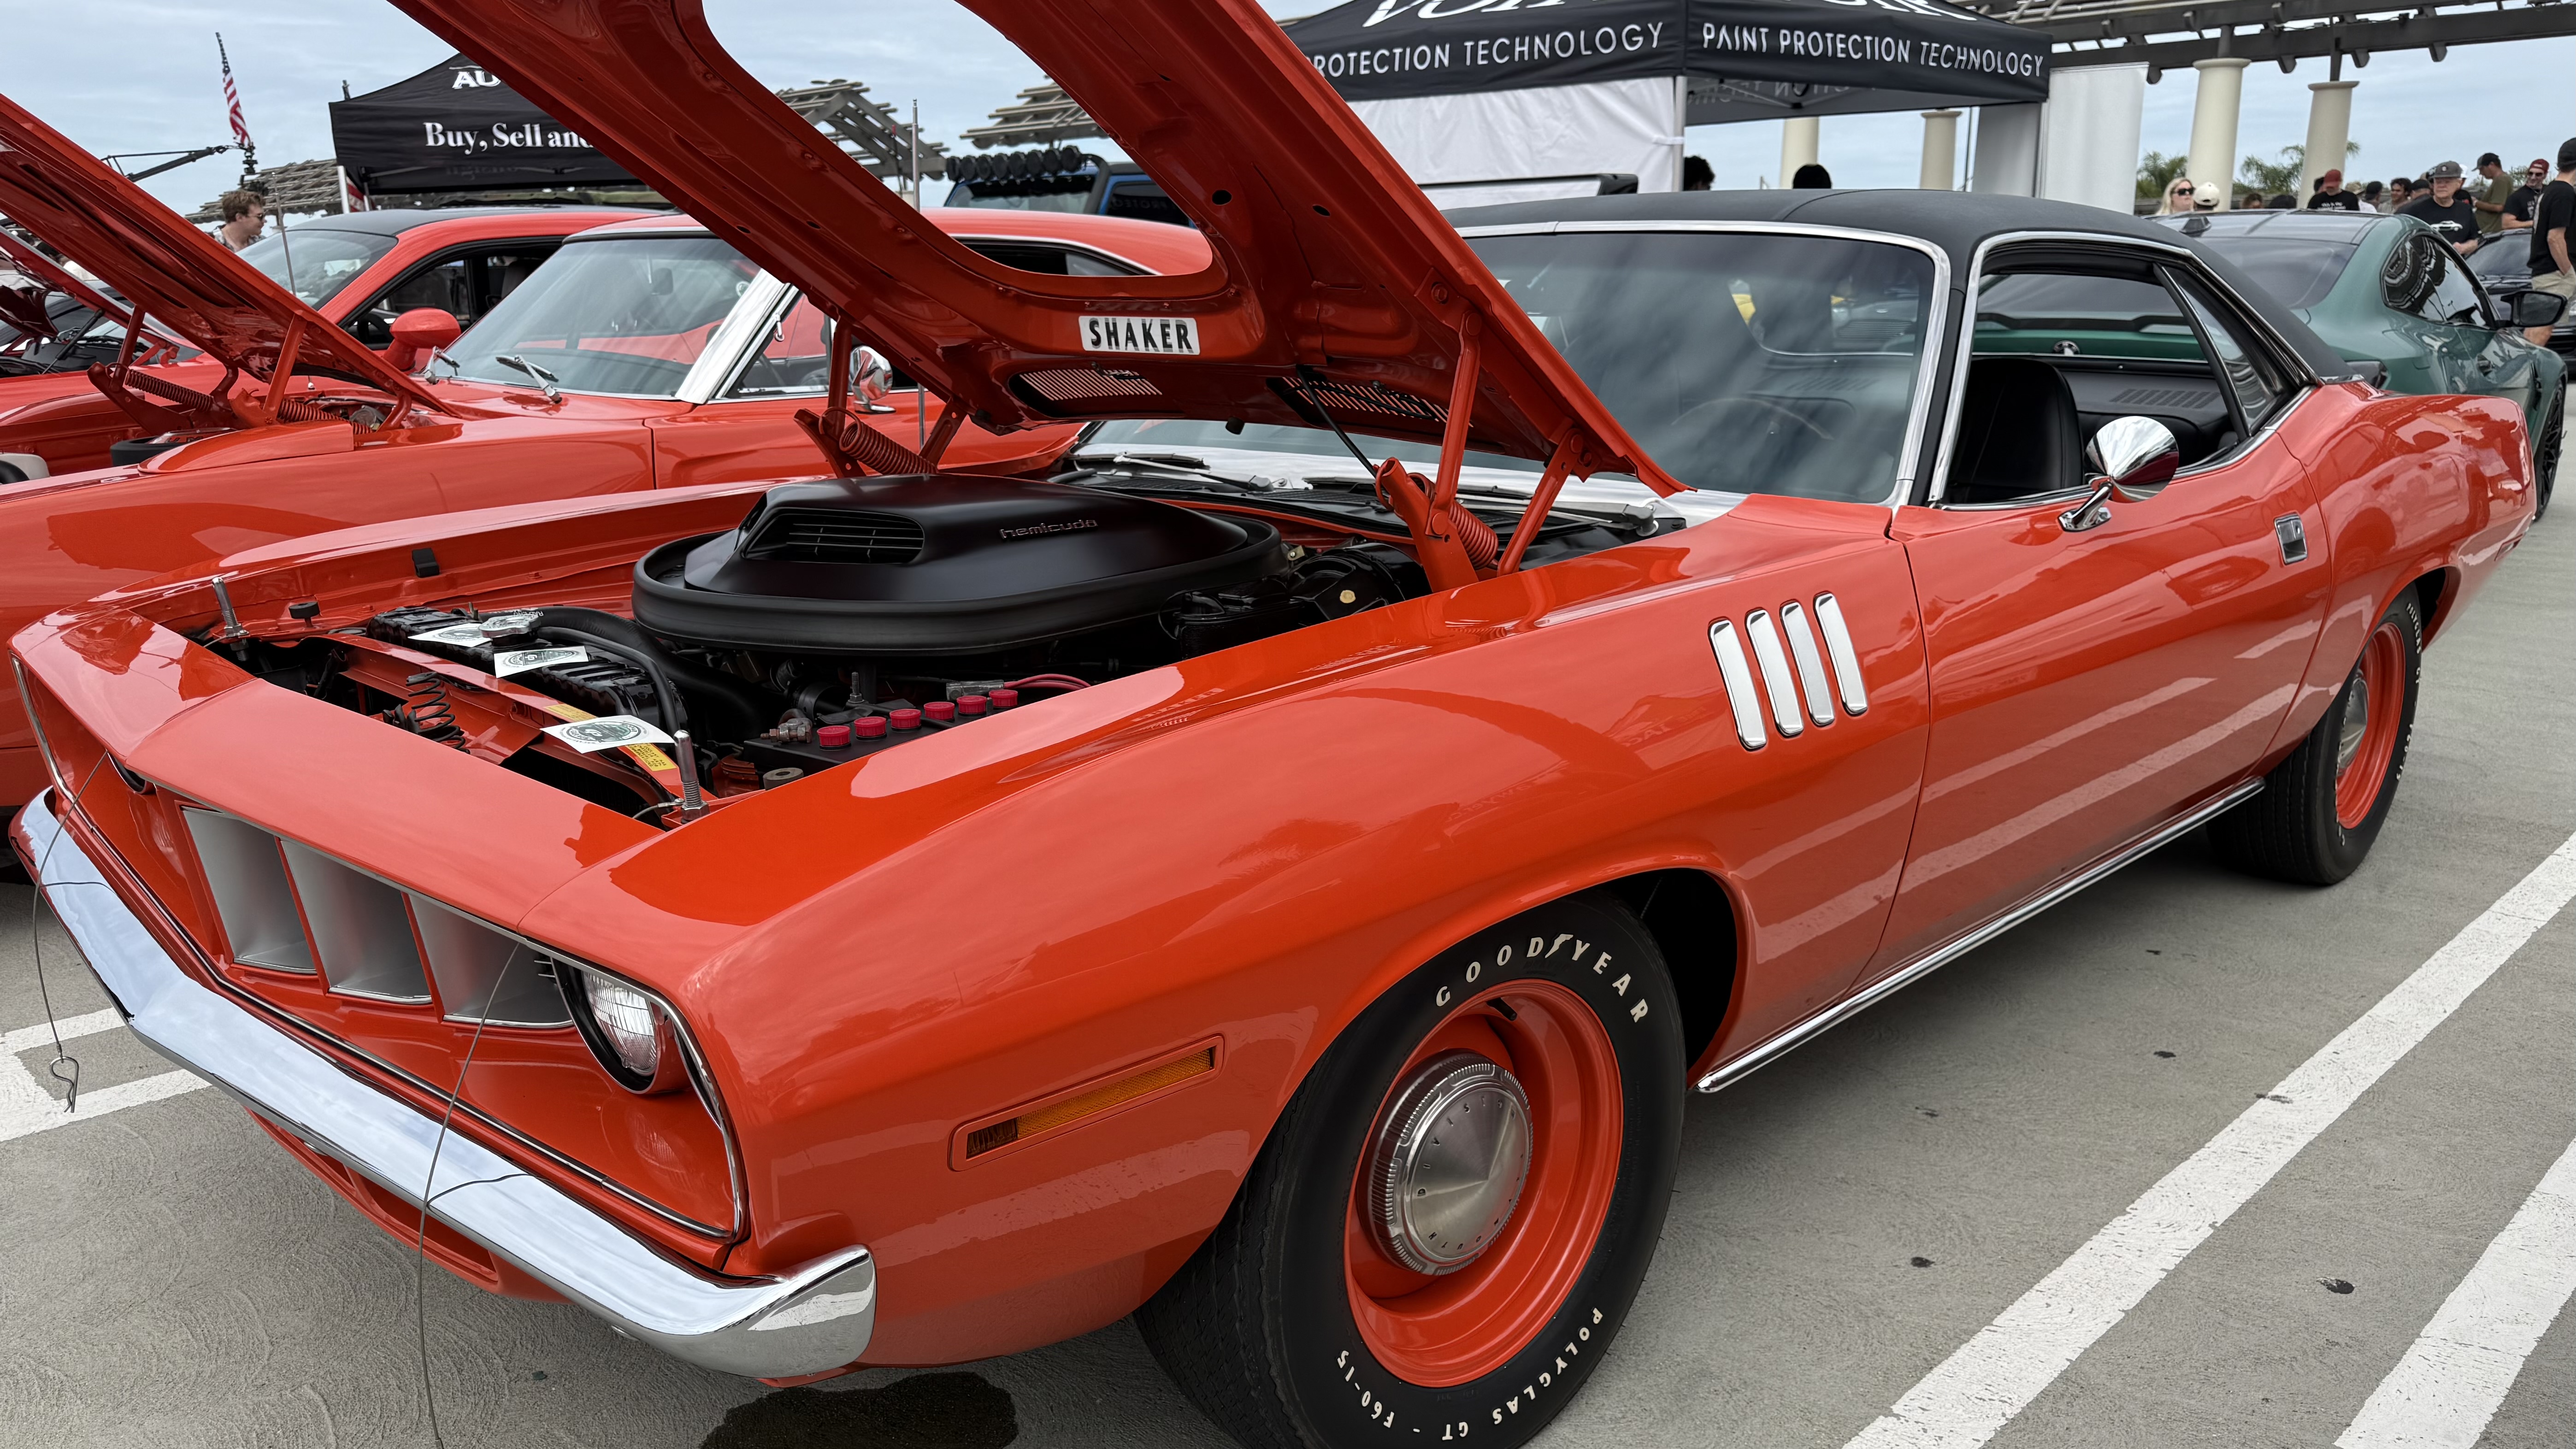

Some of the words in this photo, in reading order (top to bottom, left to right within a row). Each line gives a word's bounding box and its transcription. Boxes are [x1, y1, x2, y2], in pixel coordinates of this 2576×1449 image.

[1306, 43, 1450, 78] ROTECTION
[1464, 22, 1663, 65] TECHNOLOGY
[1703, 23, 1768, 52] PAINT
[1780, 29, 1910, 63] PROTECTION
[1920, 41, 2044, 77] TECHNOLOGY
[423, 122, 488, 155] Buy,
[492, 123, 544, 147] Sell
[1089, 318, 1194, 353] SHAKER
[1000, 519, 1098, 539] hemicuda
[1436, 934, 1648, 1023] GOODYEAR
[1337, 1350, 1395, 1428] F60-15
[1492, 1308, 1603, 1425] POLYGLAS
[1442, 1421, 1468, 1440] GT
